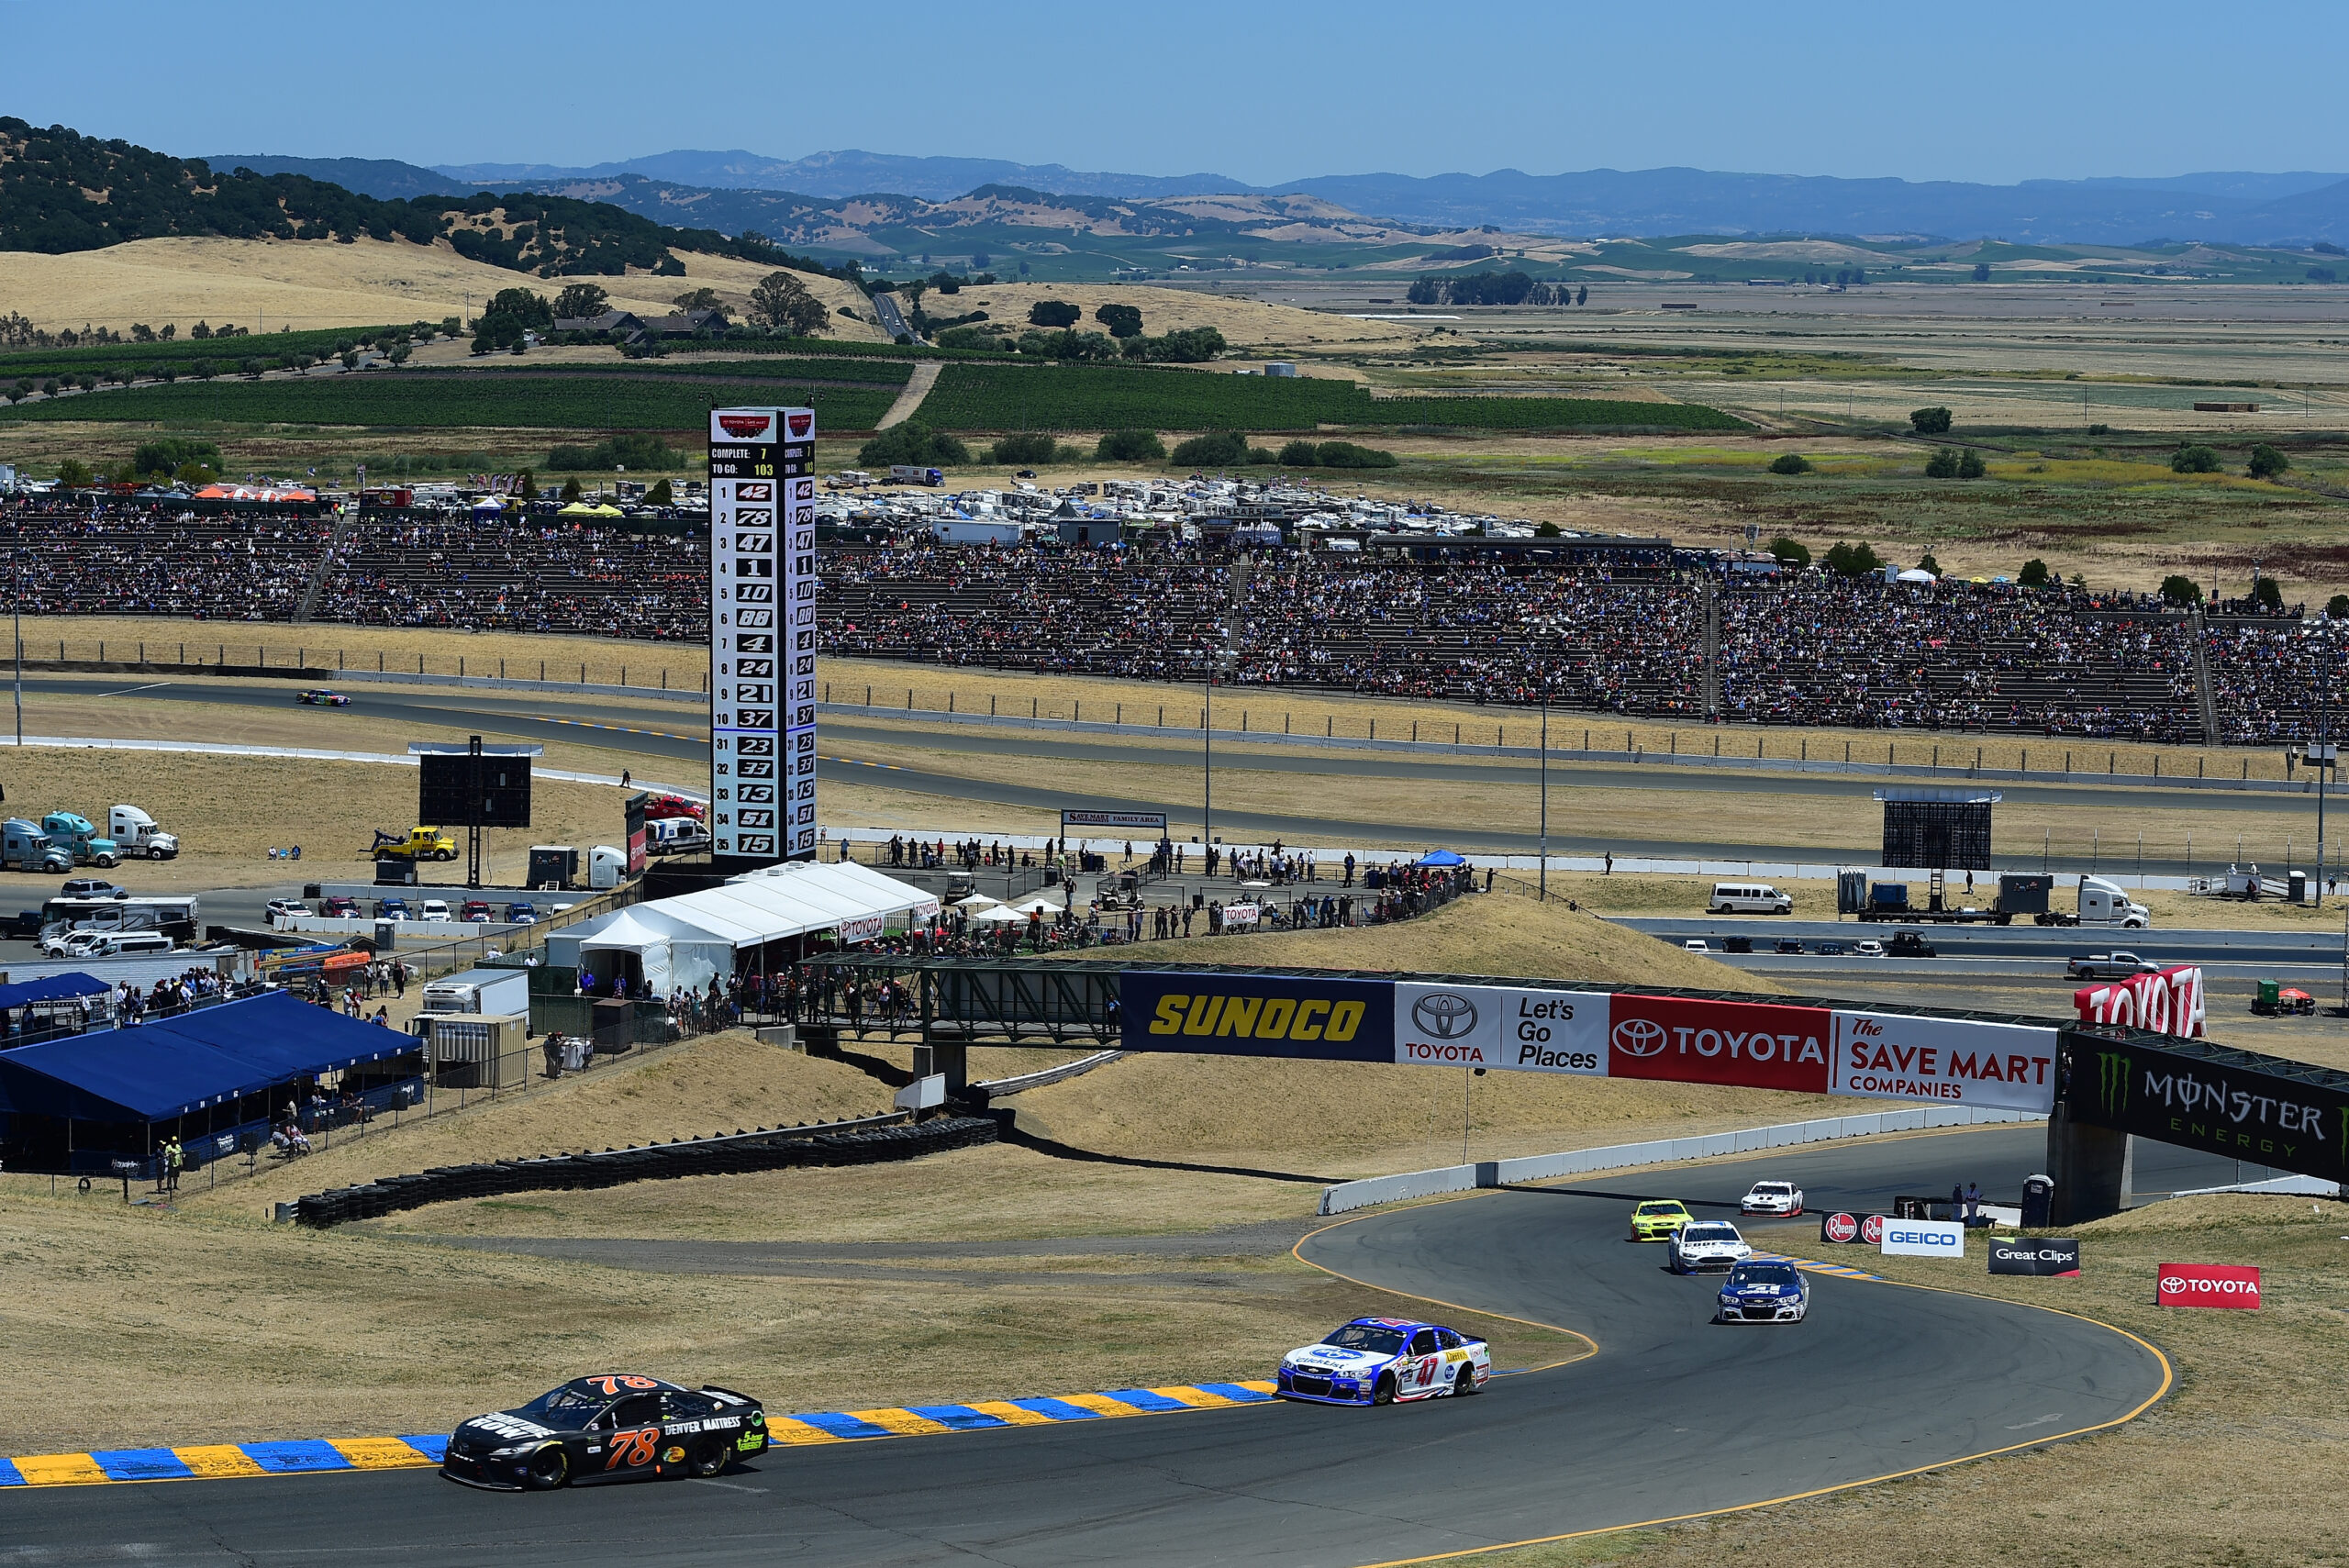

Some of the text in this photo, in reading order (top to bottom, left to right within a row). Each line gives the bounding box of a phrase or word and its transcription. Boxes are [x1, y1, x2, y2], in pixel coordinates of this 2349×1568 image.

[712, 448, 766, 459] COMPLETE: 7
[712, 464, 774, 475] TO GO: 103
[805, 462, 813, 473] 103
[721, 485, 769, 498] 1 42
[797, 484, 811, 496] 42
[720, 510, 771, 524] 2 78
[797, 508, 811, 523] 78
[720, 534, 769, 551] 3 47
[797, 531, 812, 549] 47
[719, 560, 761, 576] 4 1
[802, 558, 807, 573] 1
[721, 585, 770, 600] 5 10
[797, 582, 812, 598] 10
[721, 611, 771, 627] 6 88
[797, 607, 812, 624] 88
[721, 637, 766, 651] 7 4
[799, 632, 810, 648] 4
[721, 661, 770, 674] 8 24
[798, 657, 812, 673] 24
[721, 684, 770, 701] 9 21
[798, 681, 813, 699] 21
[717, 711, 771, 726] 10 37
[798, 707, 812, 723] 37
[717, 739, 770, 753] 31 23
[799, 735, 812, 750] 23
[717, 762, 771, 775] 32 33
[799, 758, 812, 772] 33
[717, 786, 772, 800] 33 13
[798, 782, 813, 798] 13
[717, 812, 770, 826] 34 51
[799, 806, 812, 822] 51
[1069, 813, 1091, 821] SAVE
[717, 837, 771, 851] 35 15
[799, 831, 813, 848] 15
[916, 902, 939, 917] TOYOTA
[1225, 908, 1257, 920] TOYOTA
[852, 917, 883, 937] TOYOTA
[1519, 997, 1574, 1021] Let's
[2089, 966, 2207, 1038] TOYOTA
[1148, 994, 1366, 1041] SUNOCO
[1518, 1021, 1552, 1043] Go
[1851, 1017, 1884, 1038] The
[1405, 1042, 1484, 1062] TOYOTA
[1672, 1026, 1825, 1065] TOYOTA
[1518, 1044, 1598, 1071] Places
[1850, 1040, 2052, 1085] SAVE MART
[1849, 1075, 1962, 1100] COMPANIES
[2143, 1069, 2326, 1141] MONSTER
[2170, 1118, 2297, 1158] ENERGY
[1829, 1213, 1855, 1238] Rheem
[1865, 1215, 1881, 1240] Rhe
[1889, 1230, 1956, 1246] GEICO
[1996, 1248, 2074, 1264] Great Clips
[2188, 1279, 2259, 1296] TOYOTA
[1415, 1356, 1440, 1387] 47
[587, 1374, 658, 1396] 78
[466, 1418, 529, 1439] ROW
[664, 1416, 741, 1436] DENVER MATTRESS
[604, 1428, 660, 1471] 78
